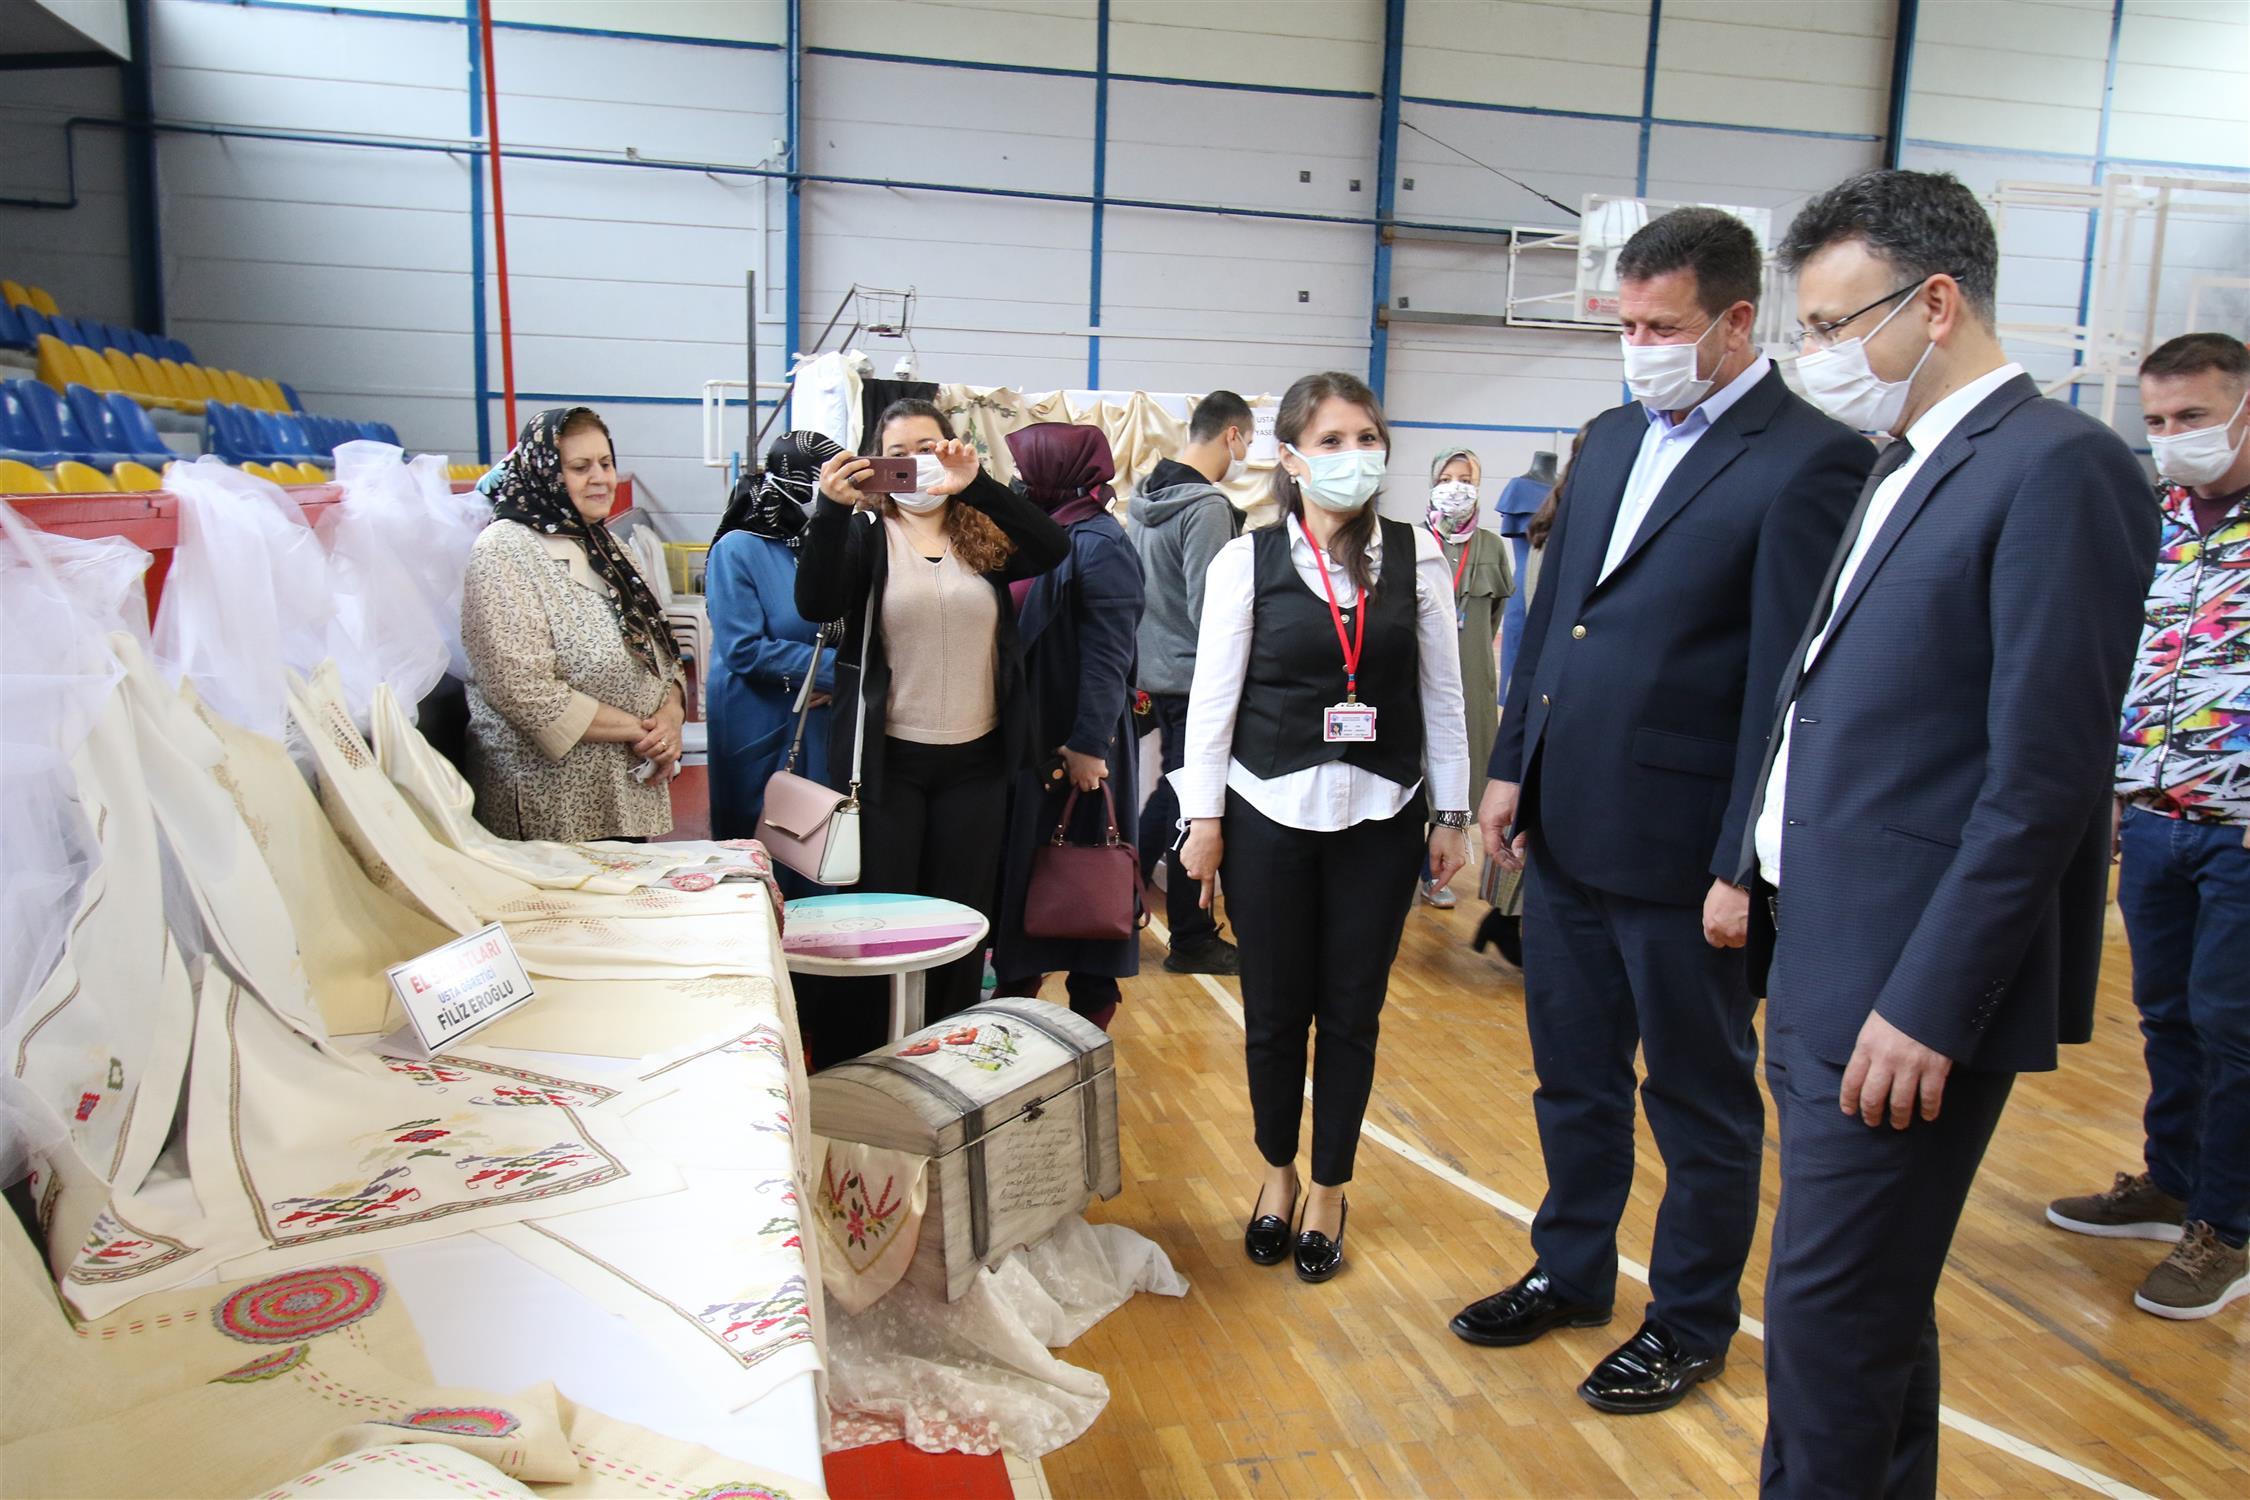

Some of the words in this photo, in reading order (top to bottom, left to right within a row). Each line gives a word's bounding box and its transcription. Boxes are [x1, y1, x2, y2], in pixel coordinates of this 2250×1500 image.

[409, 974, 432, 995] EL
[437, 987, 461, 1004] USTA
[437, 1000, 471, 1031] FİLİZ
[468, 979, 514, 1015] EROĞLU
